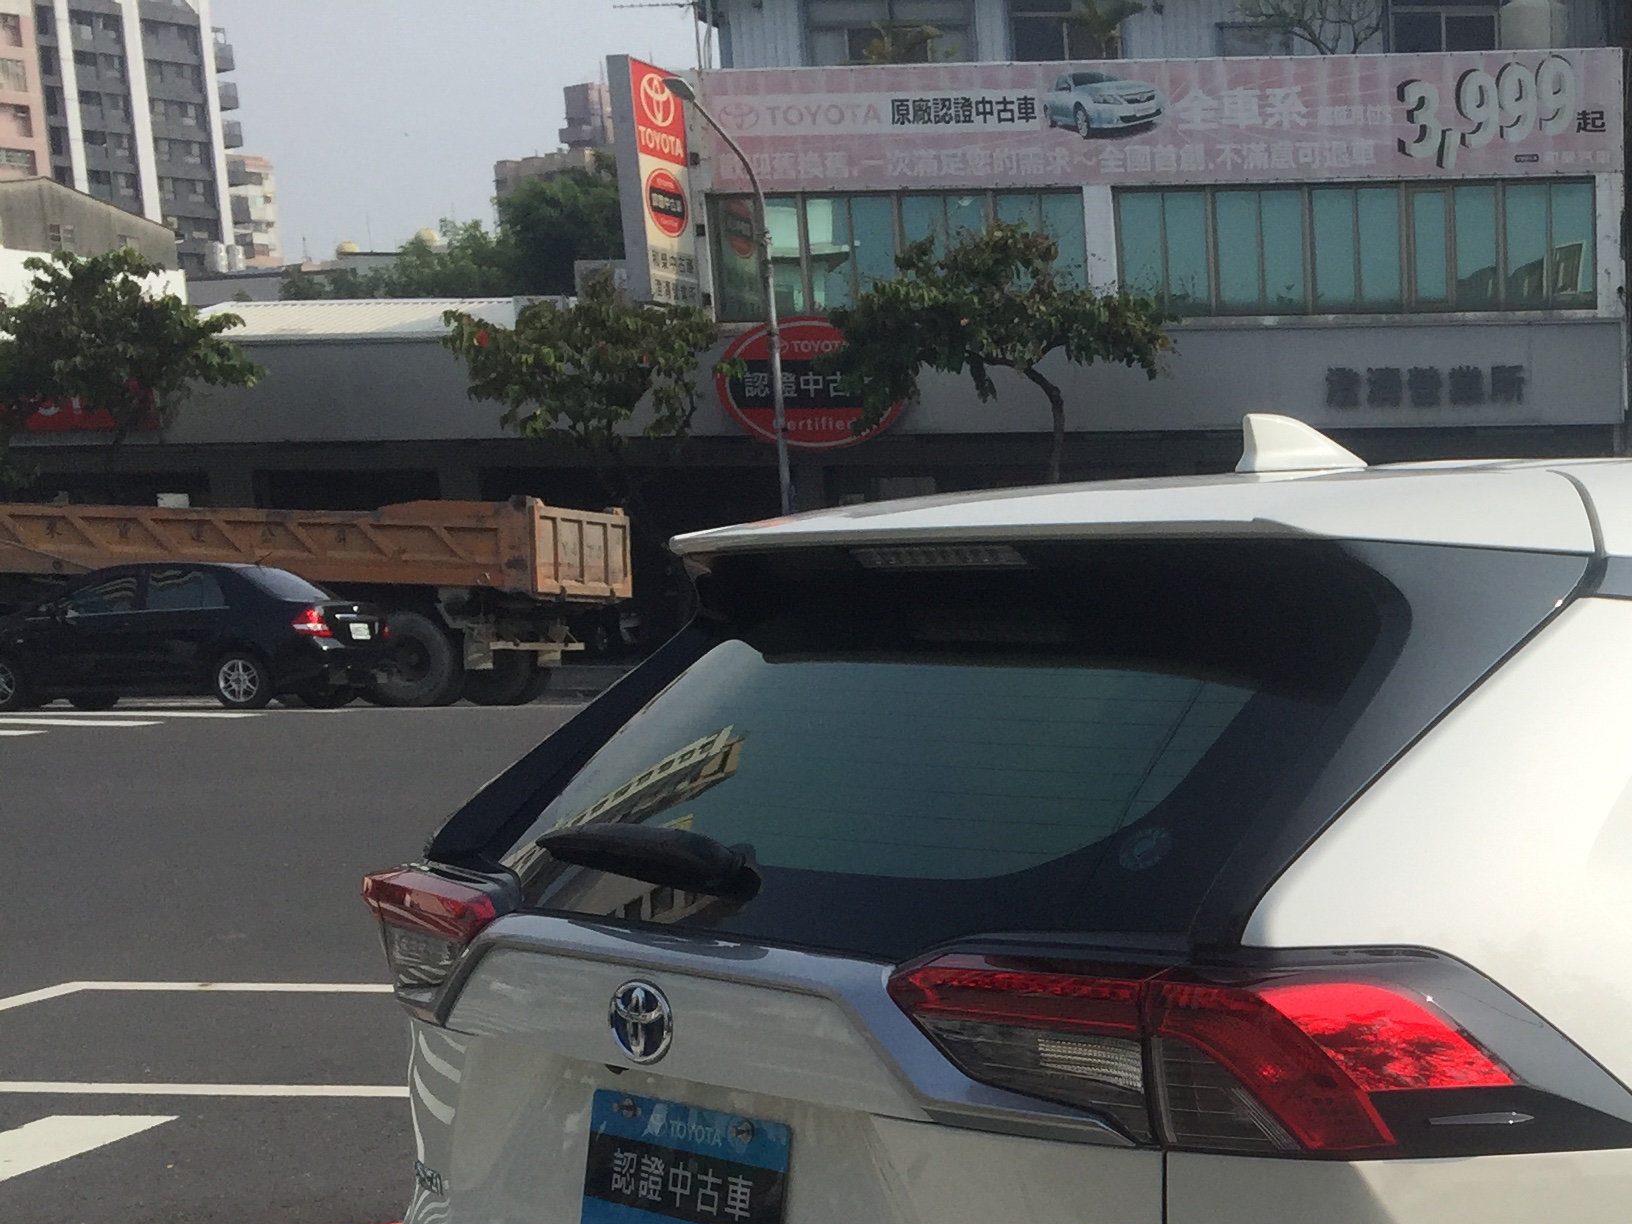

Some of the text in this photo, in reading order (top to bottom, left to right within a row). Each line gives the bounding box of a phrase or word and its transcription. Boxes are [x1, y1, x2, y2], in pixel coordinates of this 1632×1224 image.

[766, 95, 1037, 127] TOYOTA 原廠認證中古車
[1397, 54, 1577, 169] 3,999
[1576, 110, 1607, 133] 起
[638, 125, 685, 157] TOYOTA
[744, 371, 852, 398] 認證中古
[669, 1119, 723, 1147] TOYOTA
[611, 1147, 754, 1222] 認證中古車
